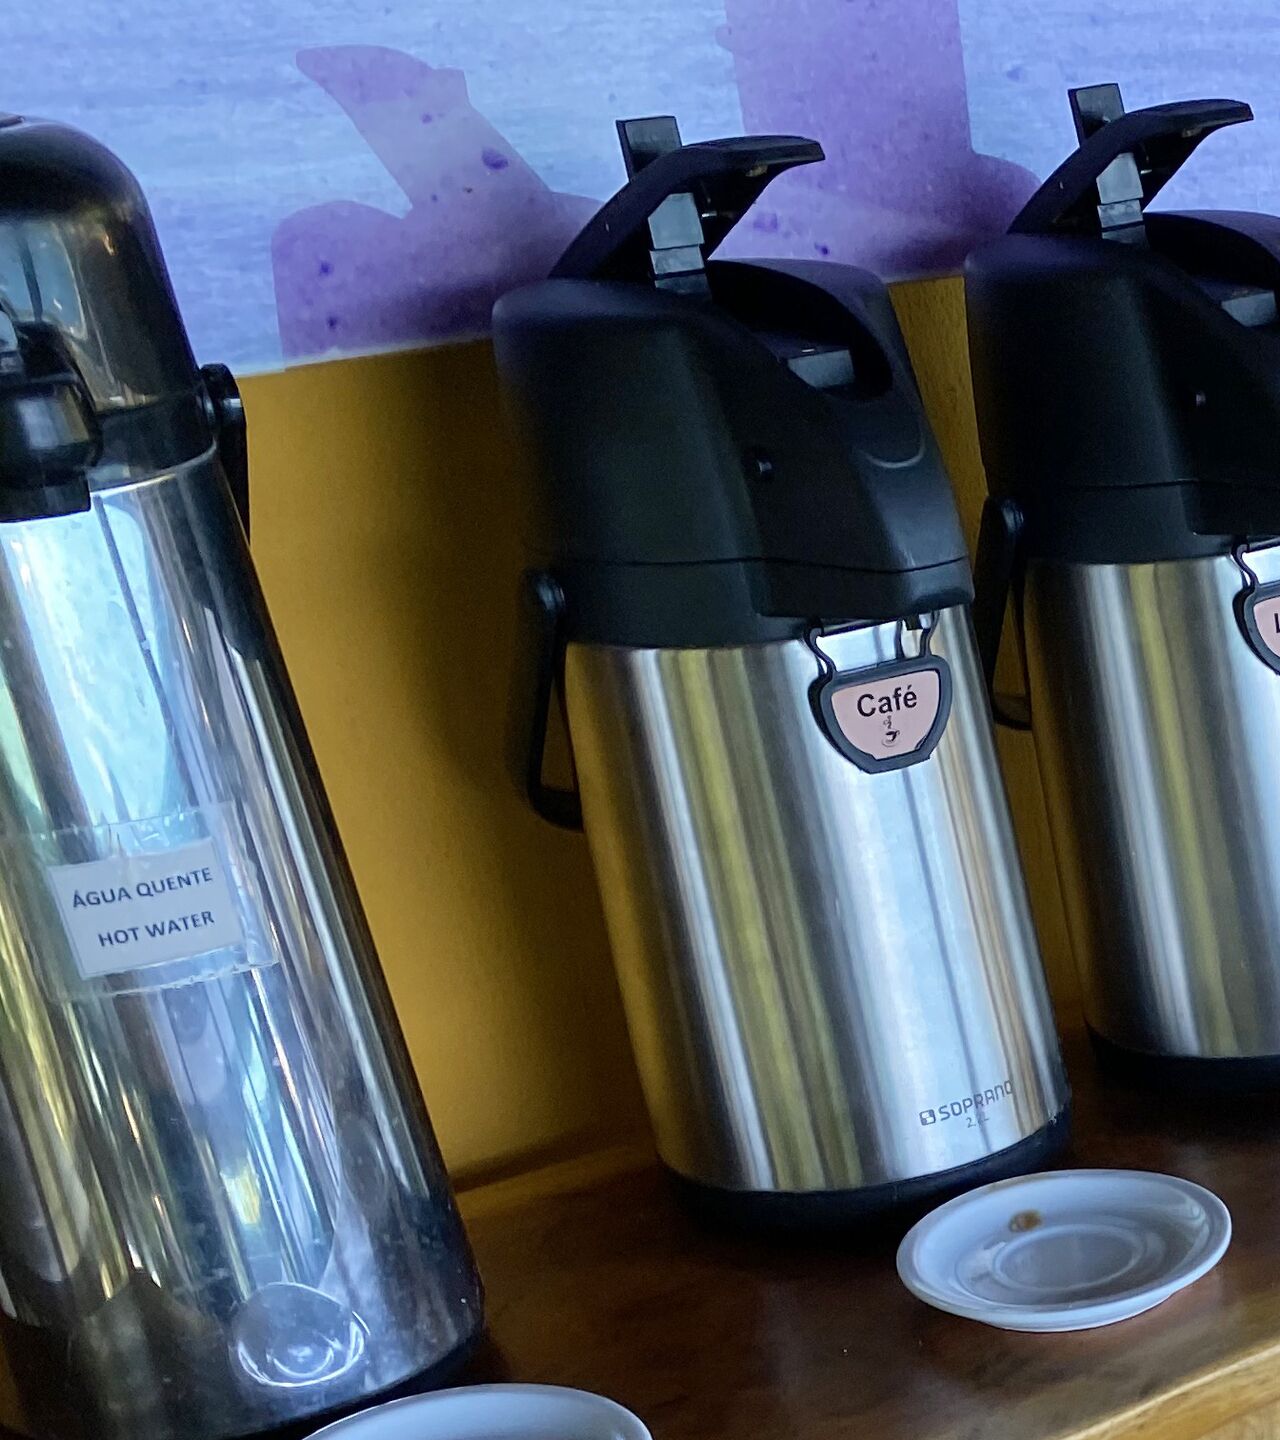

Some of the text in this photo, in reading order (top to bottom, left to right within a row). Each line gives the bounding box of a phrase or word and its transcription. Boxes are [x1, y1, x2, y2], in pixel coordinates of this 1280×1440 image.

[857, 684, 918, 717] Café
[72, 867, 214, 909] ÁGUA QUENTE
[98, 910, 215, 948] HOT WATER
[938, 1080, 1014, 1122] SOPRANO
